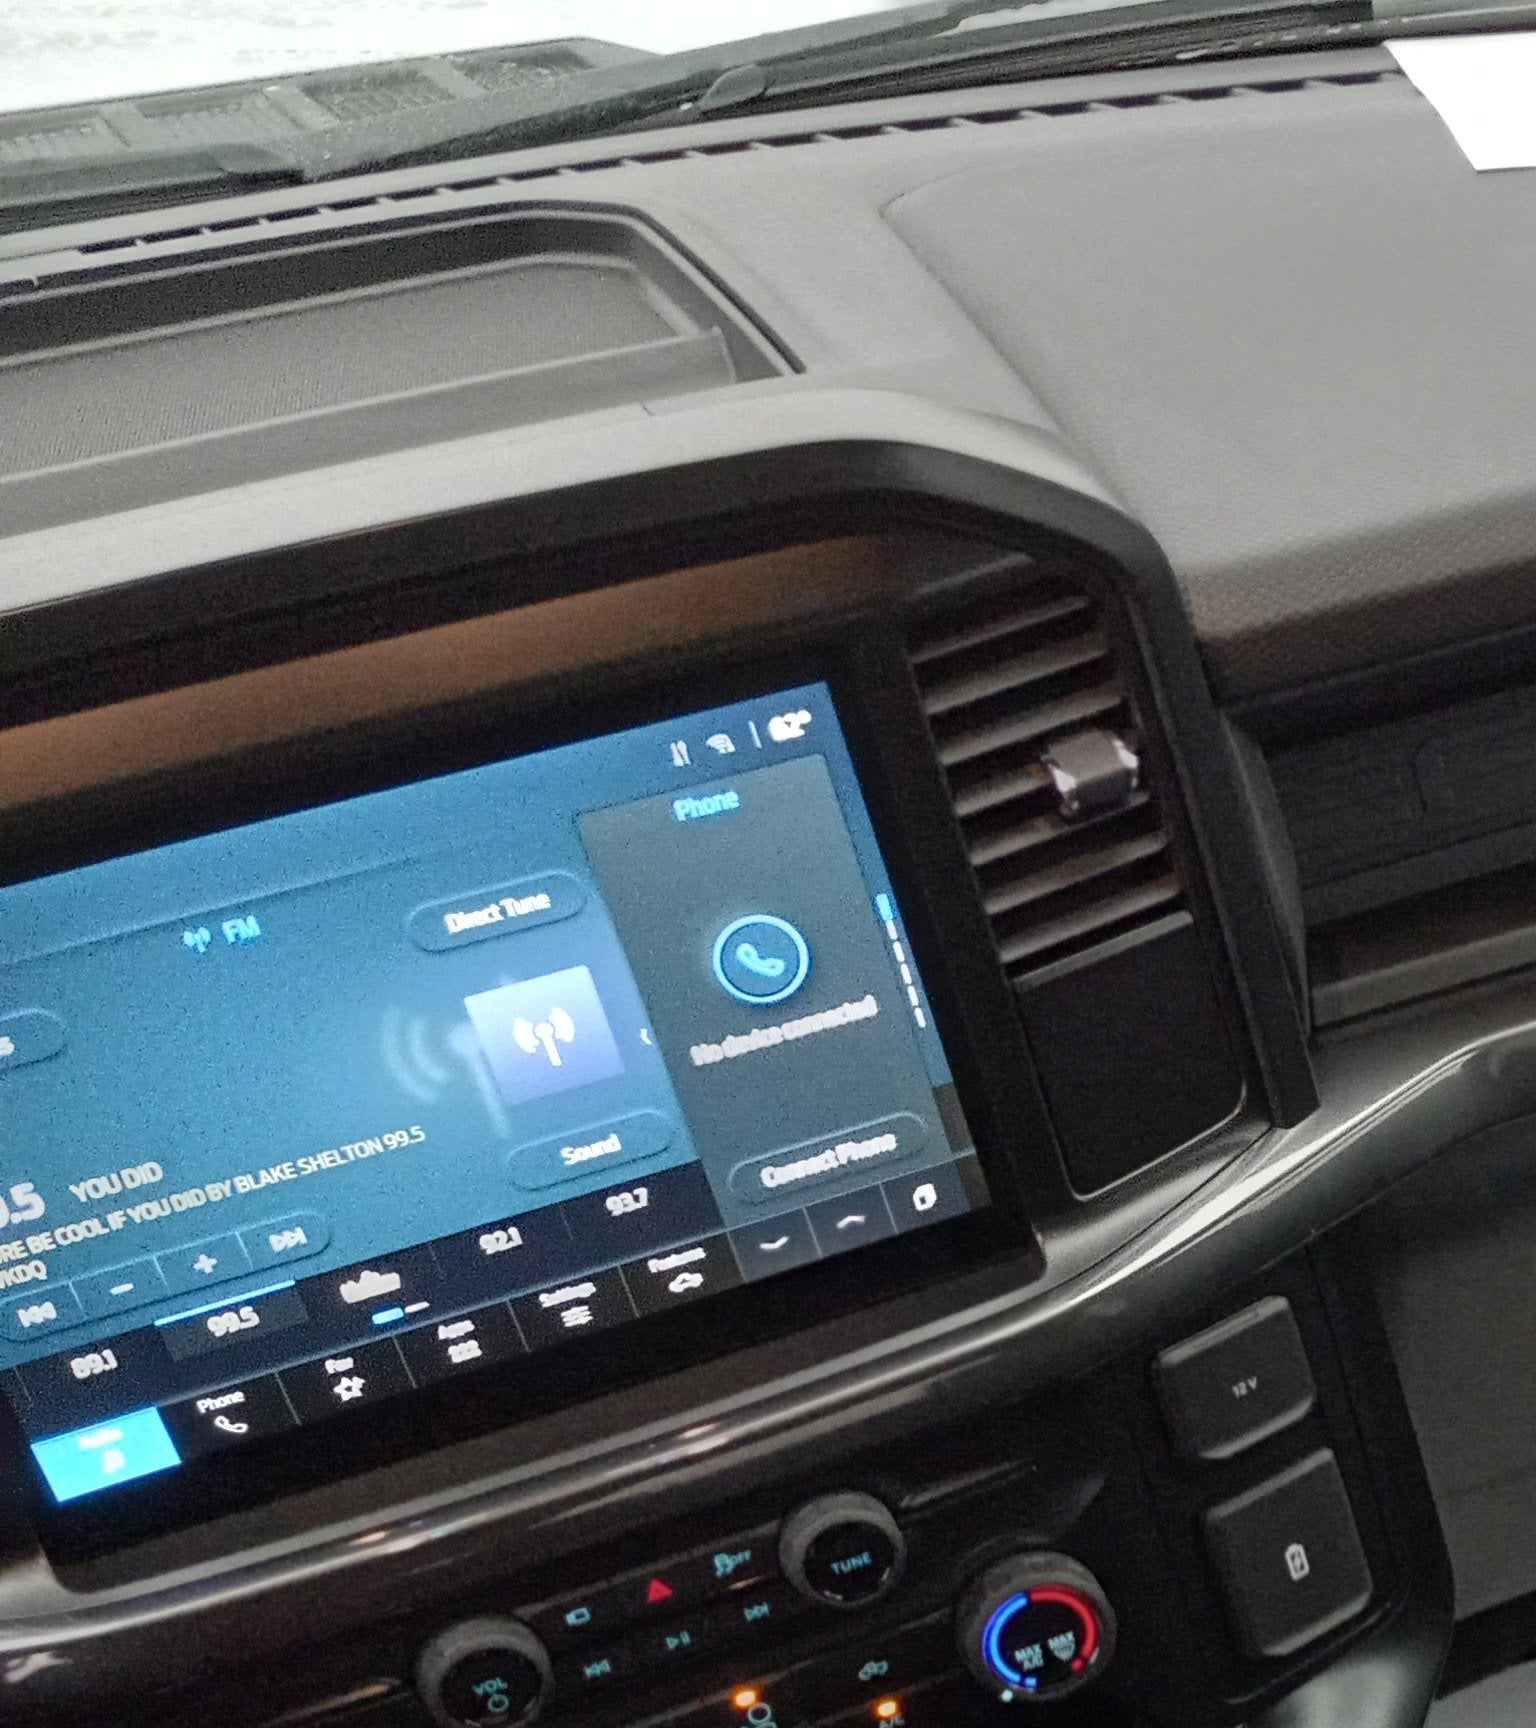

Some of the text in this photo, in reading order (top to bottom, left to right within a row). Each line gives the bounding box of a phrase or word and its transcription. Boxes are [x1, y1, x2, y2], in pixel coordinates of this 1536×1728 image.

[672, 790, 740, 822] Phone
[221, 914, 261, 945] FM
[444, 892, 552, 935] Direct Tune
[560, 1133, 622, 1166] Sound
[68, 1172, 124, 1203] YOU
[120, 1161, 164, 1189] DID
[760, 1149, 840, 1190] Connect
[25, 1231, 57, 1255] BE
[54, 1218, 110, 1246] COOL
[107, 1210, 128, 1231] IF
[126, 1198, 172, 1224] YOU
[169, 1188, 208, 1213] DID
[204, 1180, 233, 1202] BY
[233, 1161, 299, 1194] BLAKE
[296, 1137, 384, 1175] SHELTON
[383, 1125, 426, 1150] 99.5
[206, 1306, 261, 1337] 99.5
[70, 1348, 118, 1380] 89.1
[196, 1390, 246, 1414] Phone
[830, 1550, 873, 1576] TUNE
[472, 1676, 508, 1697] VOL
